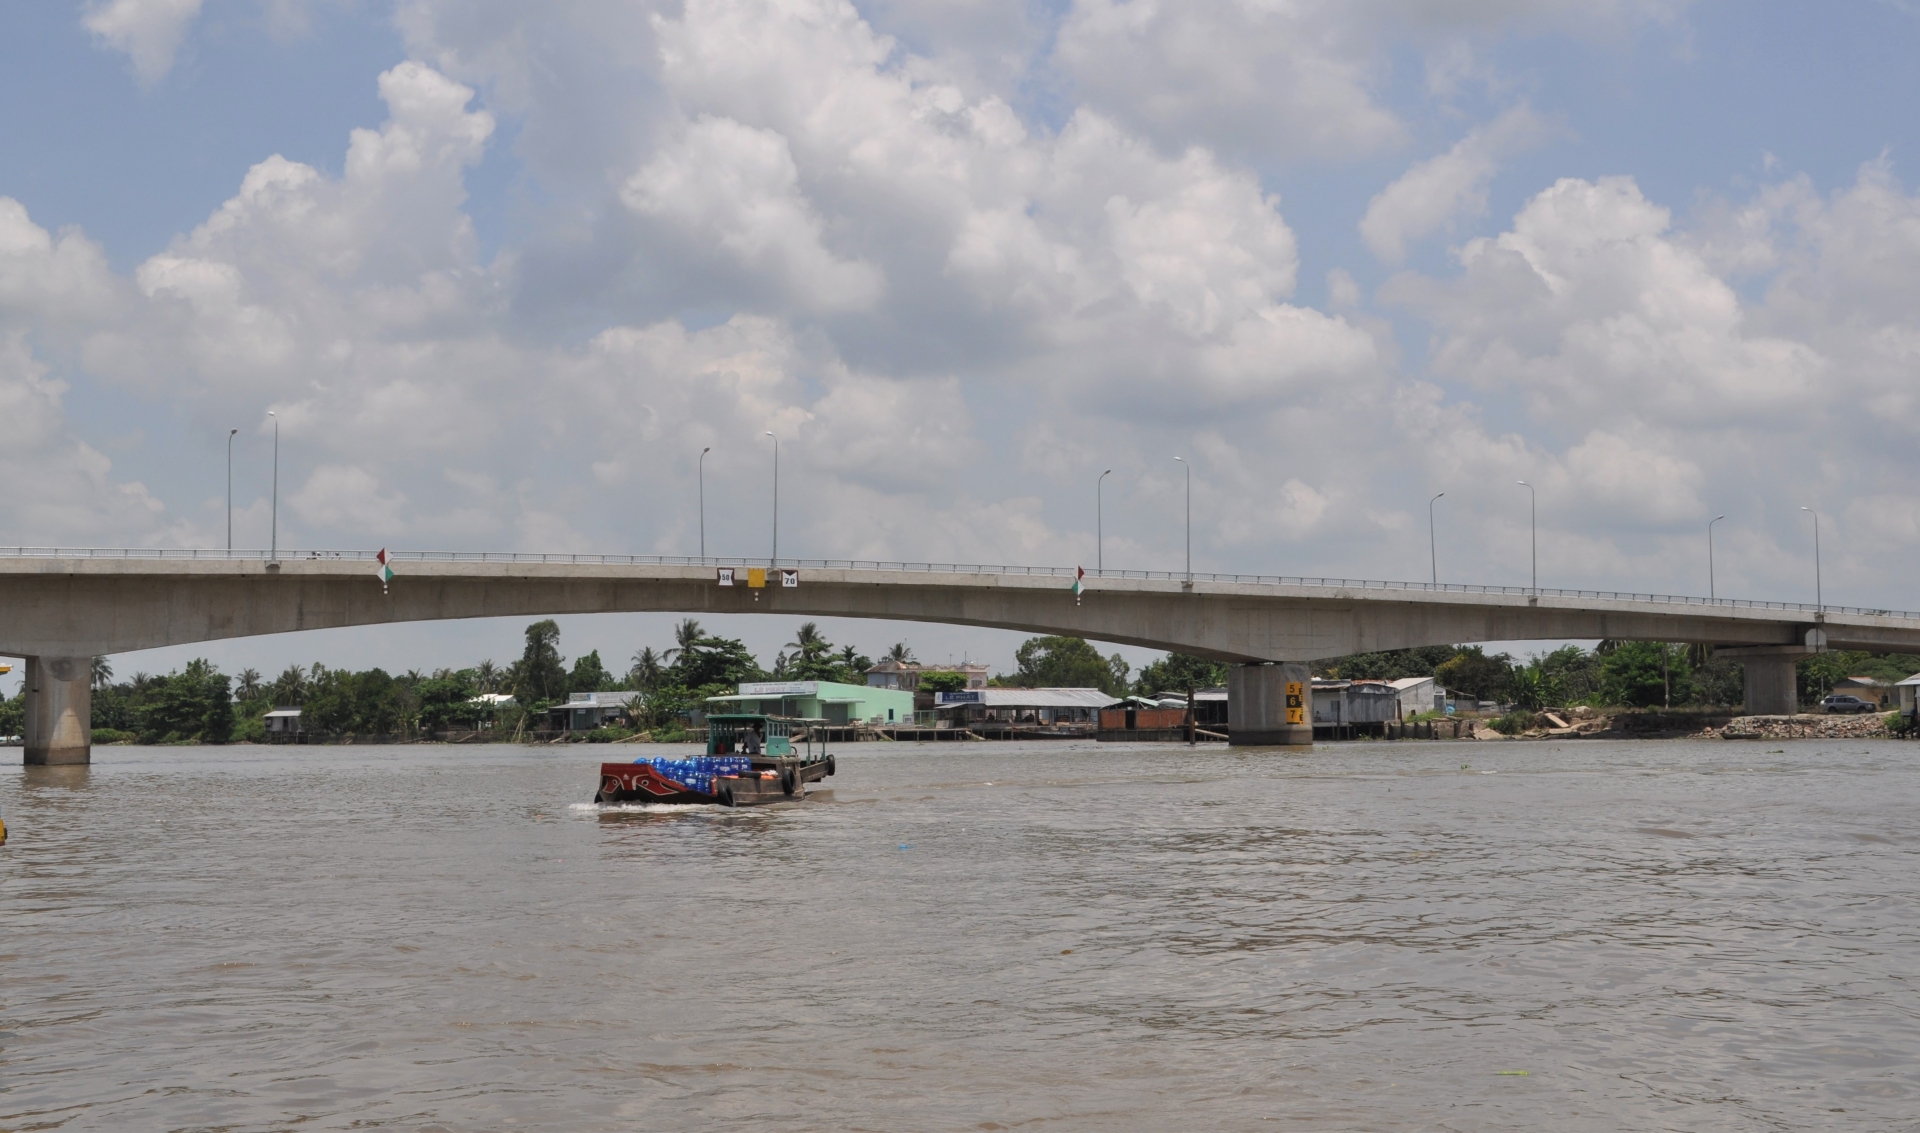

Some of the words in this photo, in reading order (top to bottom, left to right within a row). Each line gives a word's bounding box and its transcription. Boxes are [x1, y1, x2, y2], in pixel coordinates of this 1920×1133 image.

[1290, 685, 1295, 693] 5
[1290, 697, 1296, 706] 6
[1290, 710, 1296, 718] 7
